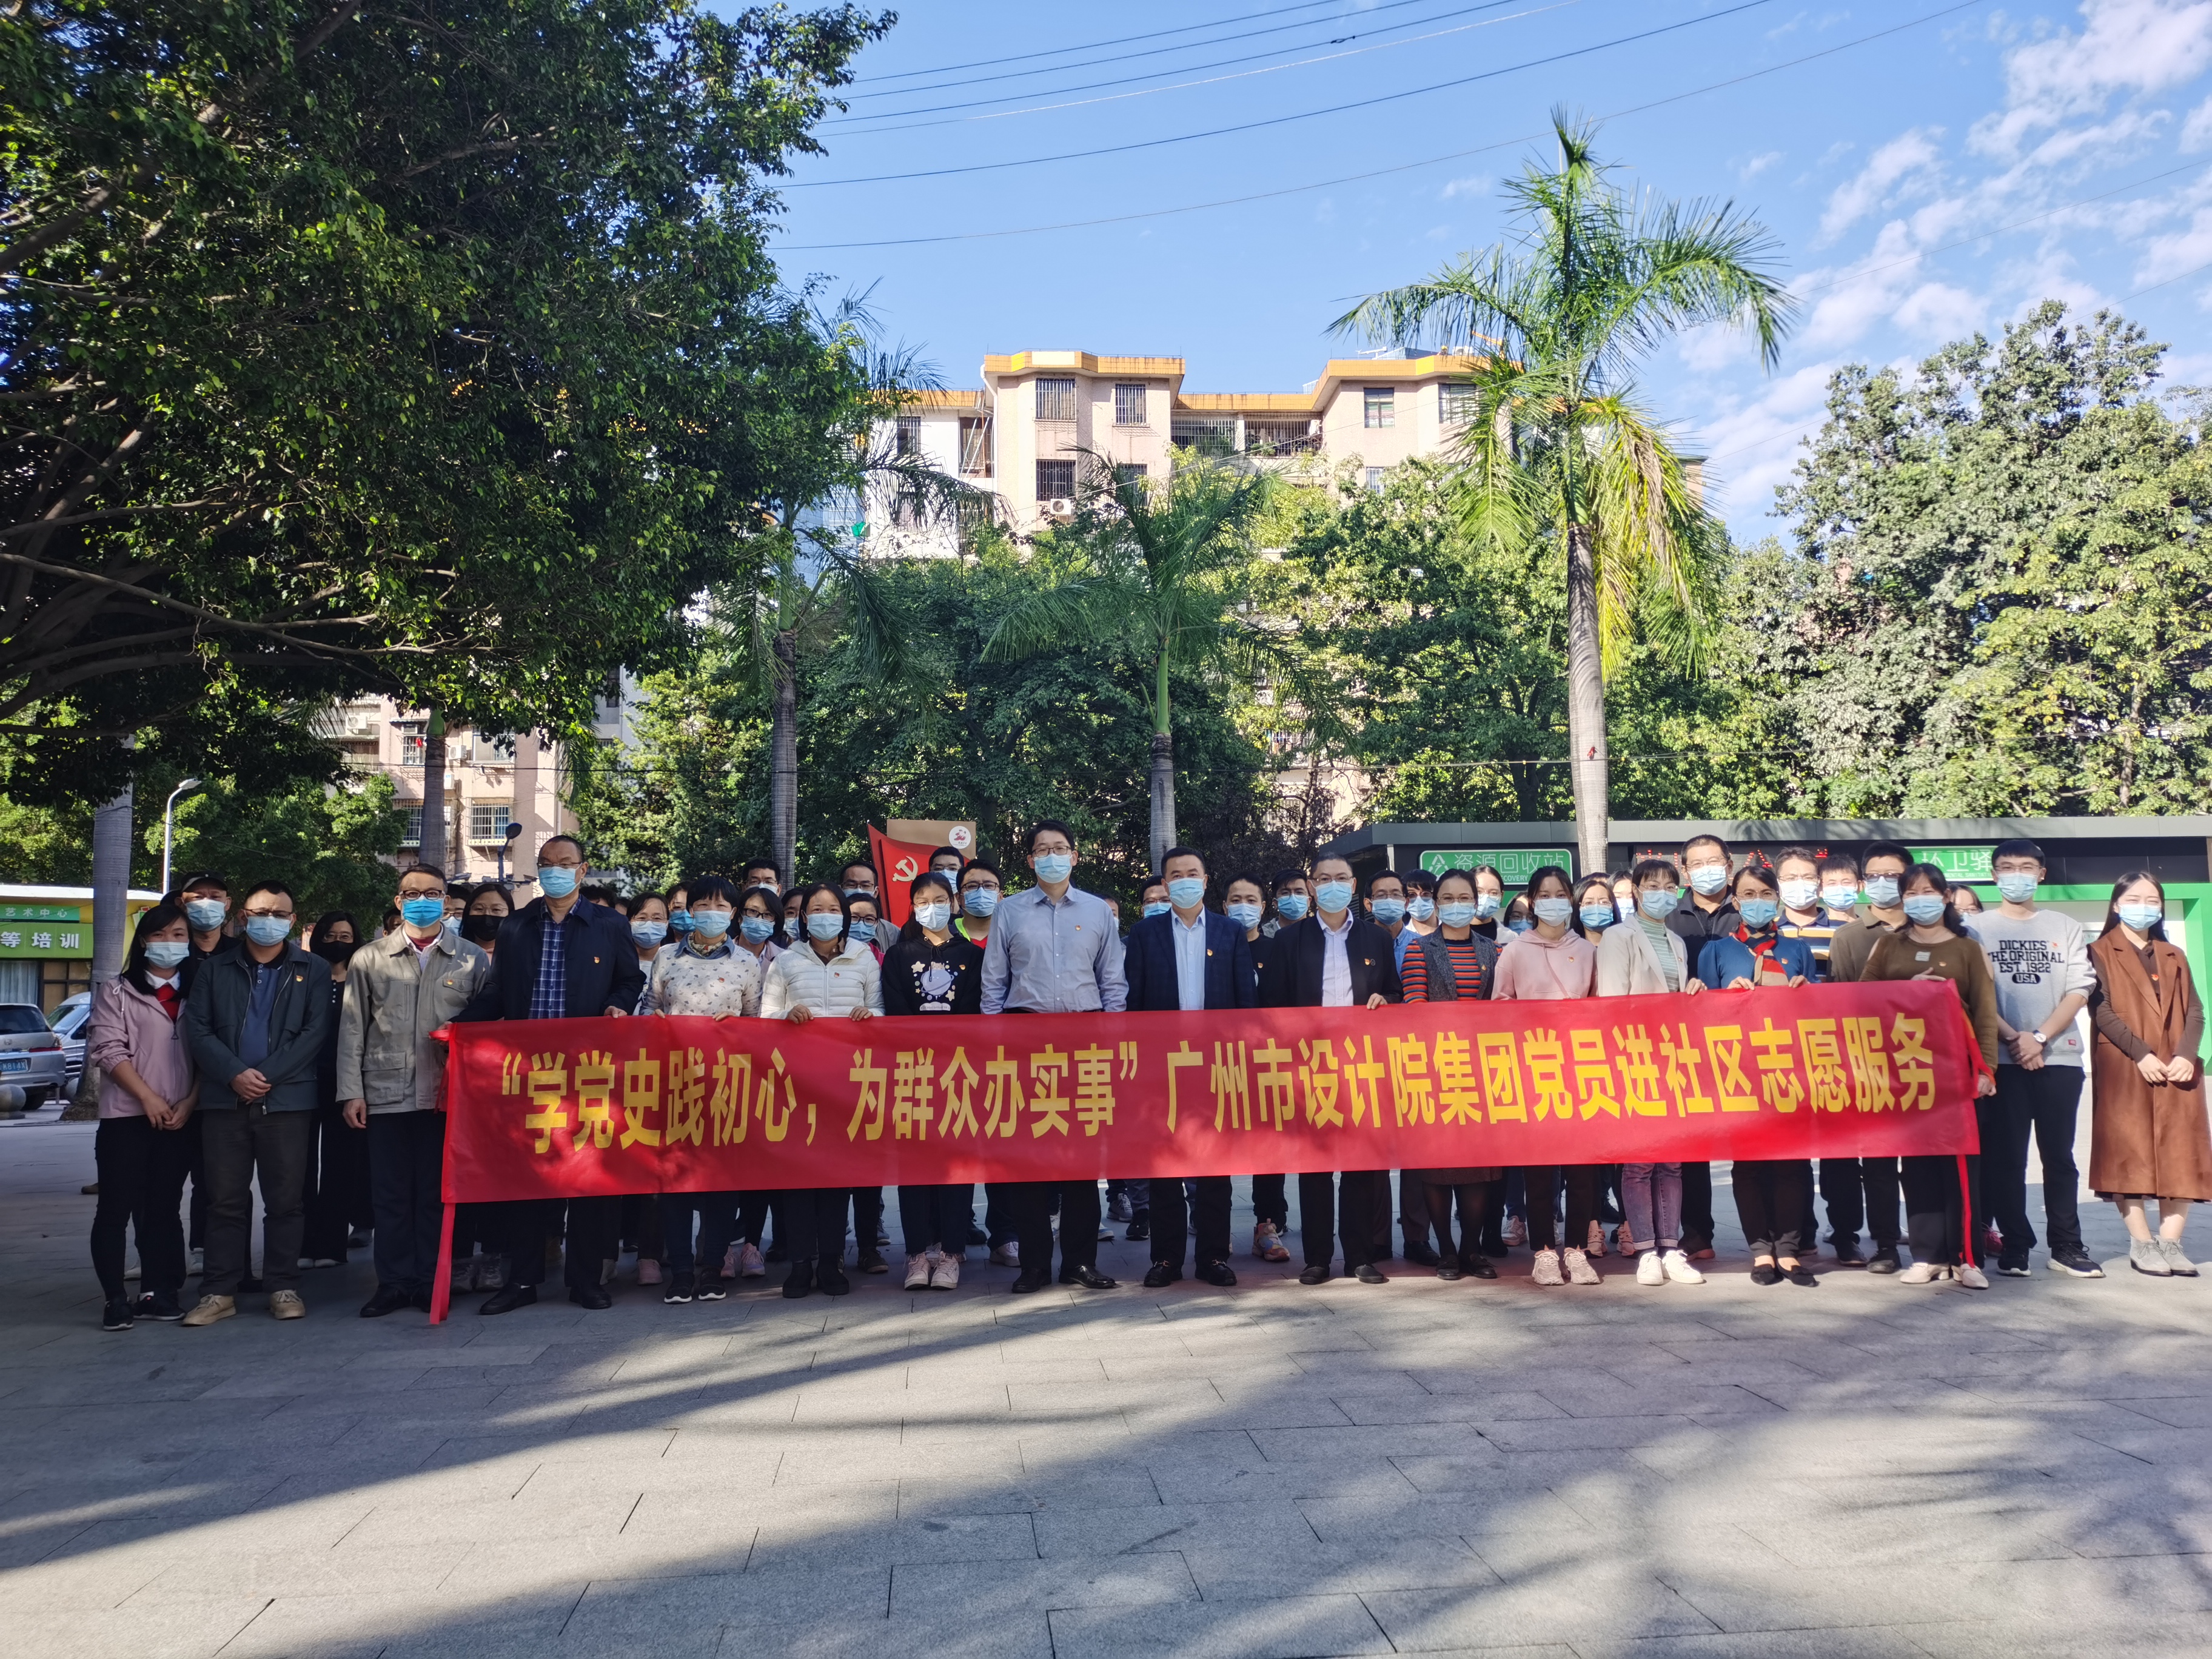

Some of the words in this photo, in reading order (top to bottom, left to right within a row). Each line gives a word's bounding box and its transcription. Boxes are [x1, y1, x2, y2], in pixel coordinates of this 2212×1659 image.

[5, 907, 67, 918] 艺术中心
[1, 931, 79, 949] 等培训
[1999, 940, 2047, 951] DICKIES
[2009, 951, 2065, 963] ORIGINAL
[2016, 973, 2037, 984] USA
